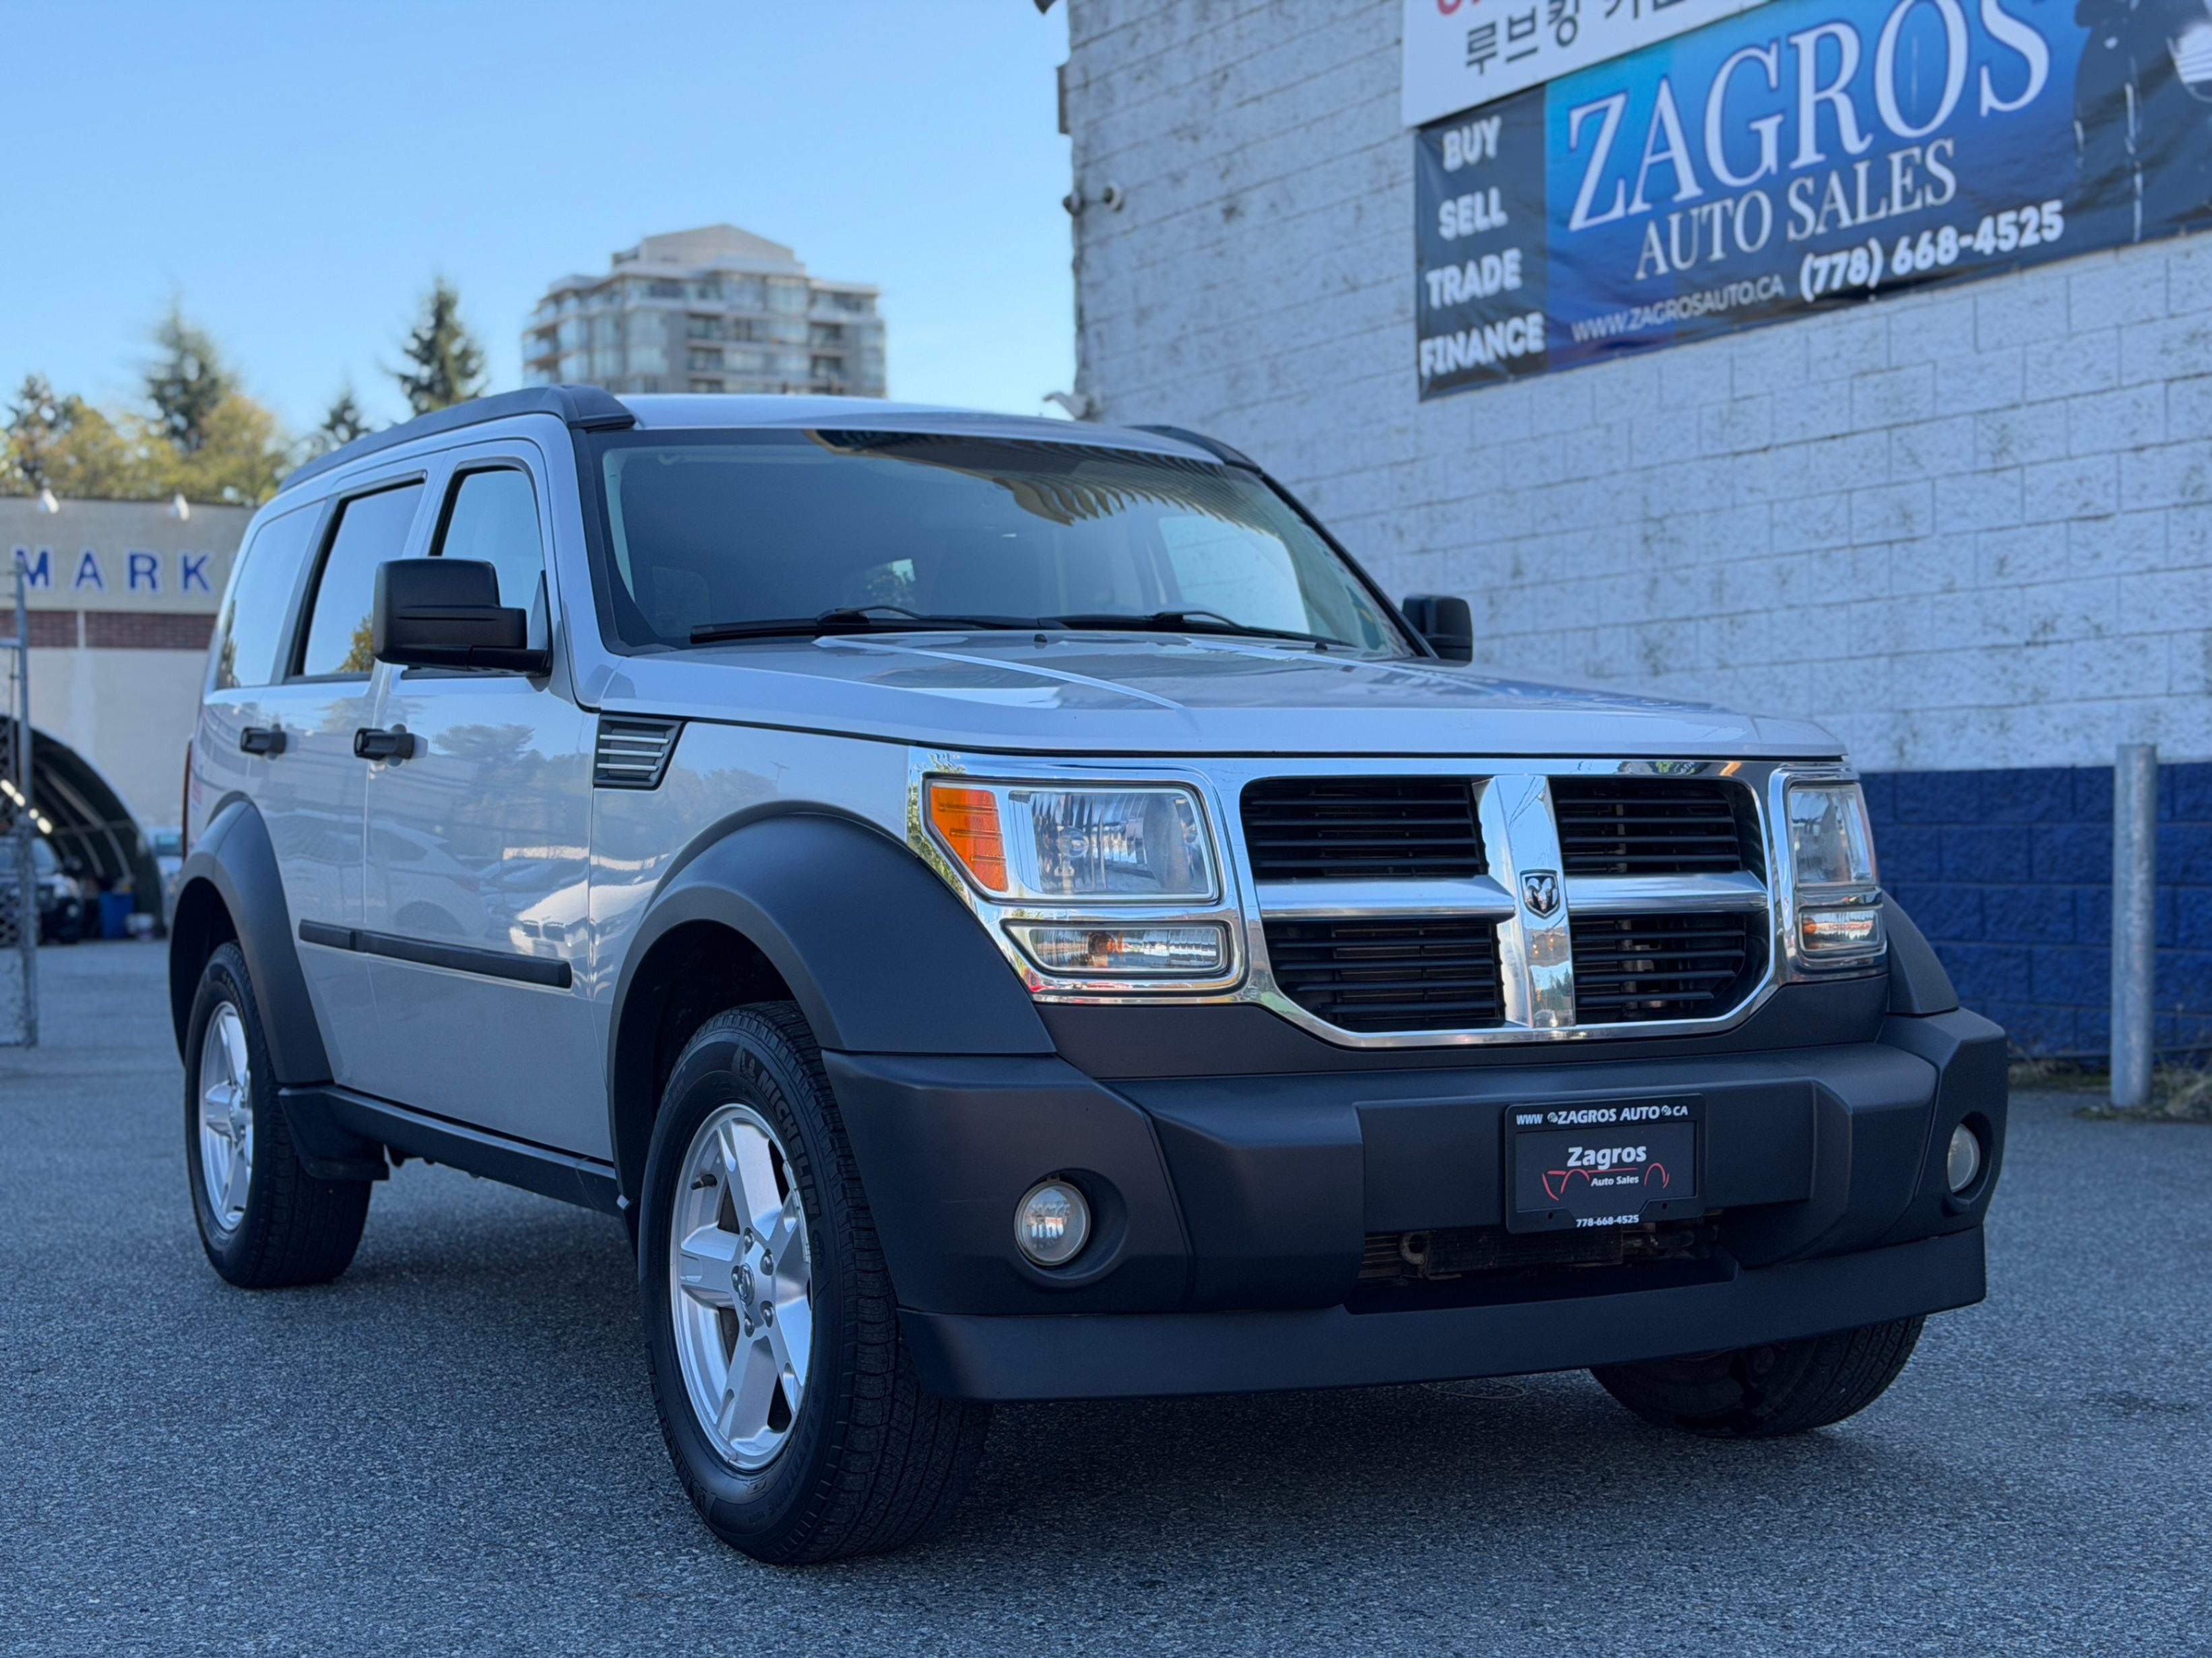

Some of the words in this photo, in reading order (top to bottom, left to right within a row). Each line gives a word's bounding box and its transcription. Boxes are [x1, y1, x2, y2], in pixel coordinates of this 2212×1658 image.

[1442, 115, 1501, 172] BUY
[1568, 0, 2050, 231] ZAGROS
[1439, 187, 1509, 241] SELL
[1635, 189, 1773, 281] AUTO
[1786, 138, 1957, 242] SALES
[1426, 249, 1523, 310] TRADE
[1800, 236, 1884, 302] (778)
[1891, 200, 2064, 277] 668-4525
[1571, 274, 1786, 343] WWW.ZAGROSAUTO.CA
[1420, 312, 1545, 378] FINANCE
[756, 1069, 822, 1217] MICHELIN
[1516, 1114, 1543, 1125] WWW
[1567, 1145, 1647, 1170] Zagros
[1590, 1177, 1614, 1187] Auto
[1616, 1175, 1639, 1185] Sales
[1576, 1215, 1639, 1227] 778-668-4525
